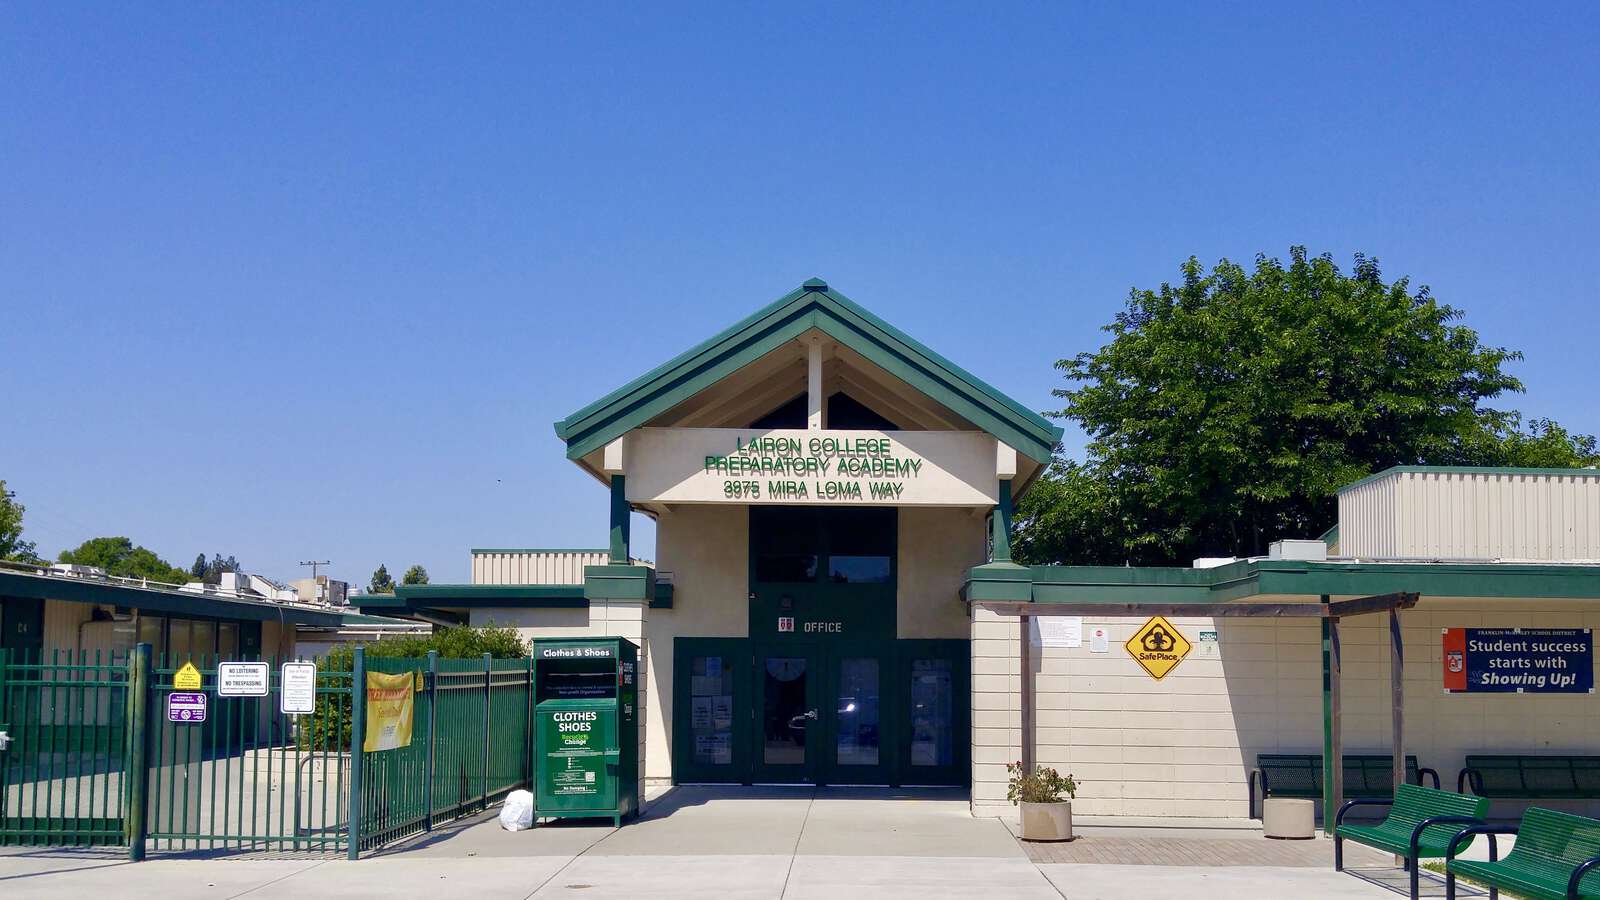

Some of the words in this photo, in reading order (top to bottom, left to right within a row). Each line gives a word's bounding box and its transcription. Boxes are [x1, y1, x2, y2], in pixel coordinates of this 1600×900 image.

[736, 437, 801, 452] LAIRON
[808, 438, 891, 452] COLLEGE
[704, 456, 830, 472] PREPARATORY
[836, 457, 922, 473] ACADEMY
[723, 480, 760, 493] 3975
[768, 481, 808, 494] MIRA
[816, 481, 862, 494] LOMA
[869, 482, 903, 495] WAY
[804, 622, 842, 633] OFFICE
[543, 649, 575, 657] Clothes
[576, 649, 582, 657] &
[584, 648, 610, 657] Shoes
[1469, 640, 1527, 652] Student
[1532, 643, 1586, 653] success
[1489, 657, 1531, 669] starts
[1535, 656, 1567, 669] with
[1481, 673, 1546, 688] Showing
[1550, 673, 1576, 688] Up!
[553, 711, 597, 722] CLOTHES
[558, 722, 592, 732] SHOES
